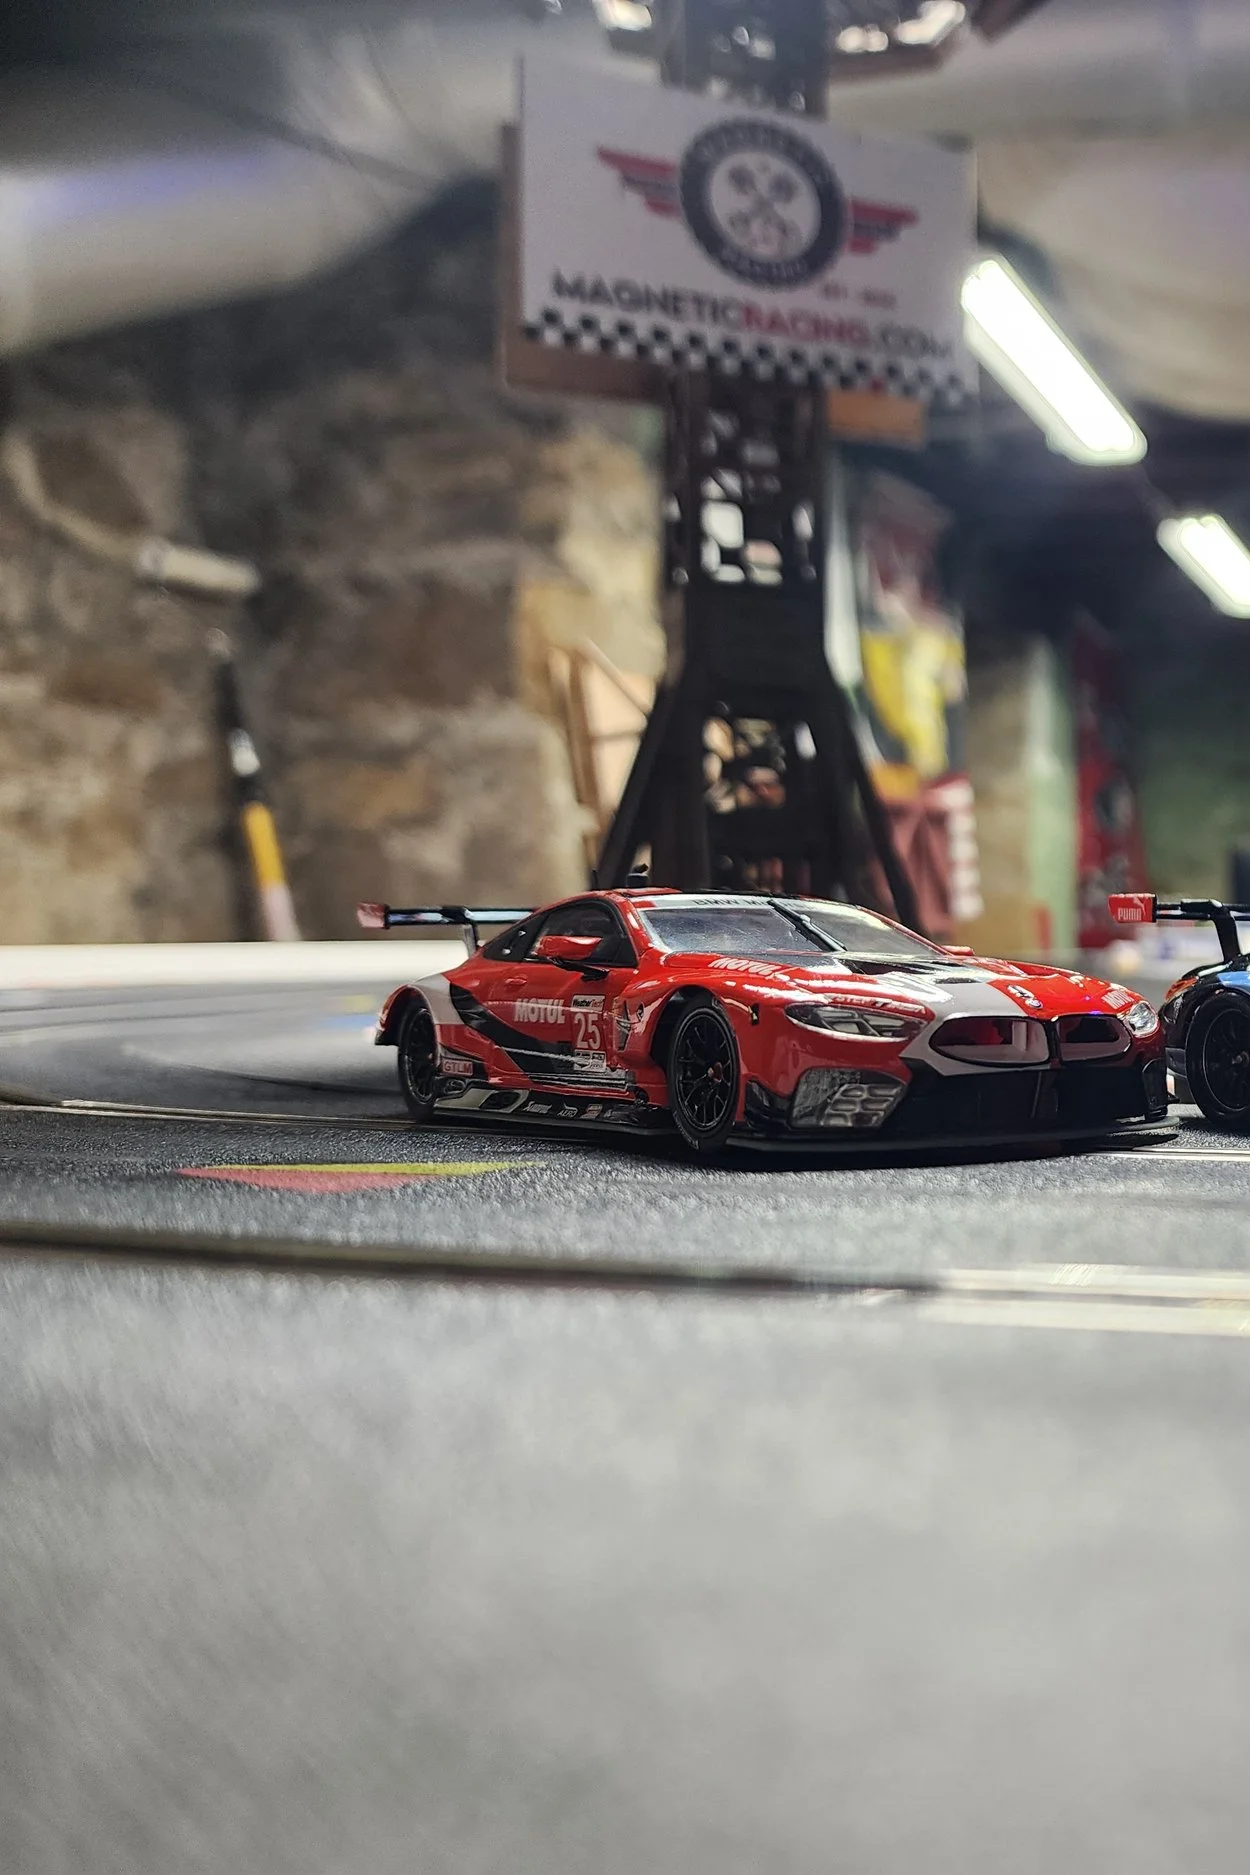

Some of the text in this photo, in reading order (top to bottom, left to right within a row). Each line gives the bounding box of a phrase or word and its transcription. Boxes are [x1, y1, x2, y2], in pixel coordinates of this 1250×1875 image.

[1118, 907, 1142, 921] PUMA
[707, 957, 782, 976] MOTUL
[514, 998, 566, 1024] MOTUL
[573, 1013, 601, 1049] 25
[445, 1060, 472, 1073] GTLM
